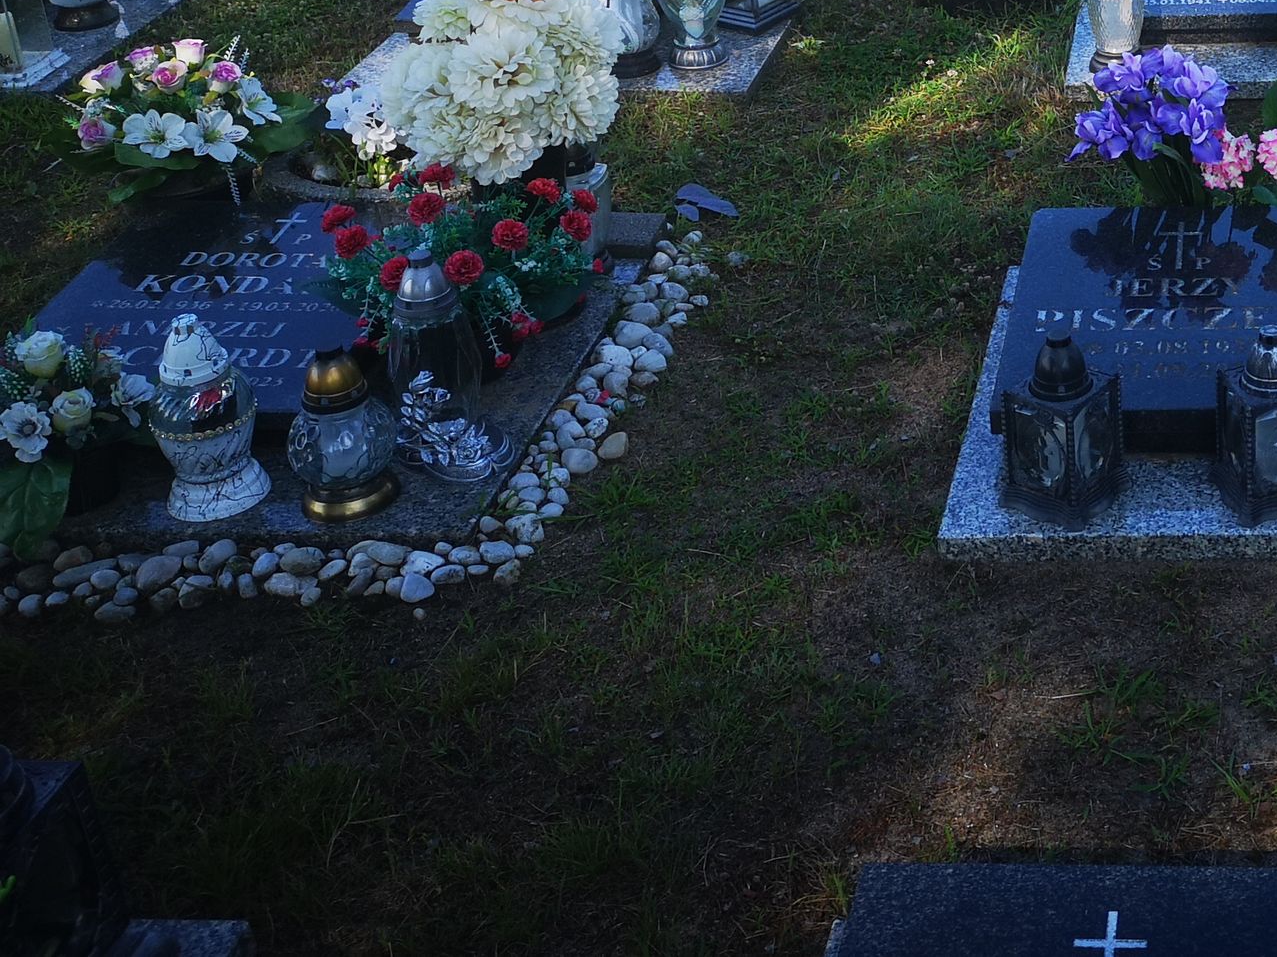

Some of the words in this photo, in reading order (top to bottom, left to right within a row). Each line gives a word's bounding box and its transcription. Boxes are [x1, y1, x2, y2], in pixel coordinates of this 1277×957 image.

[240, 229, 260, 245] Ś
[292, 233, 312, 245] P
[1147, 253, 1162, 271] Ś
[1194, 256, 1211, 270] P
[132, 274, 309, 294] KONDA
[1105, 277, 1242, 297] JERZY
